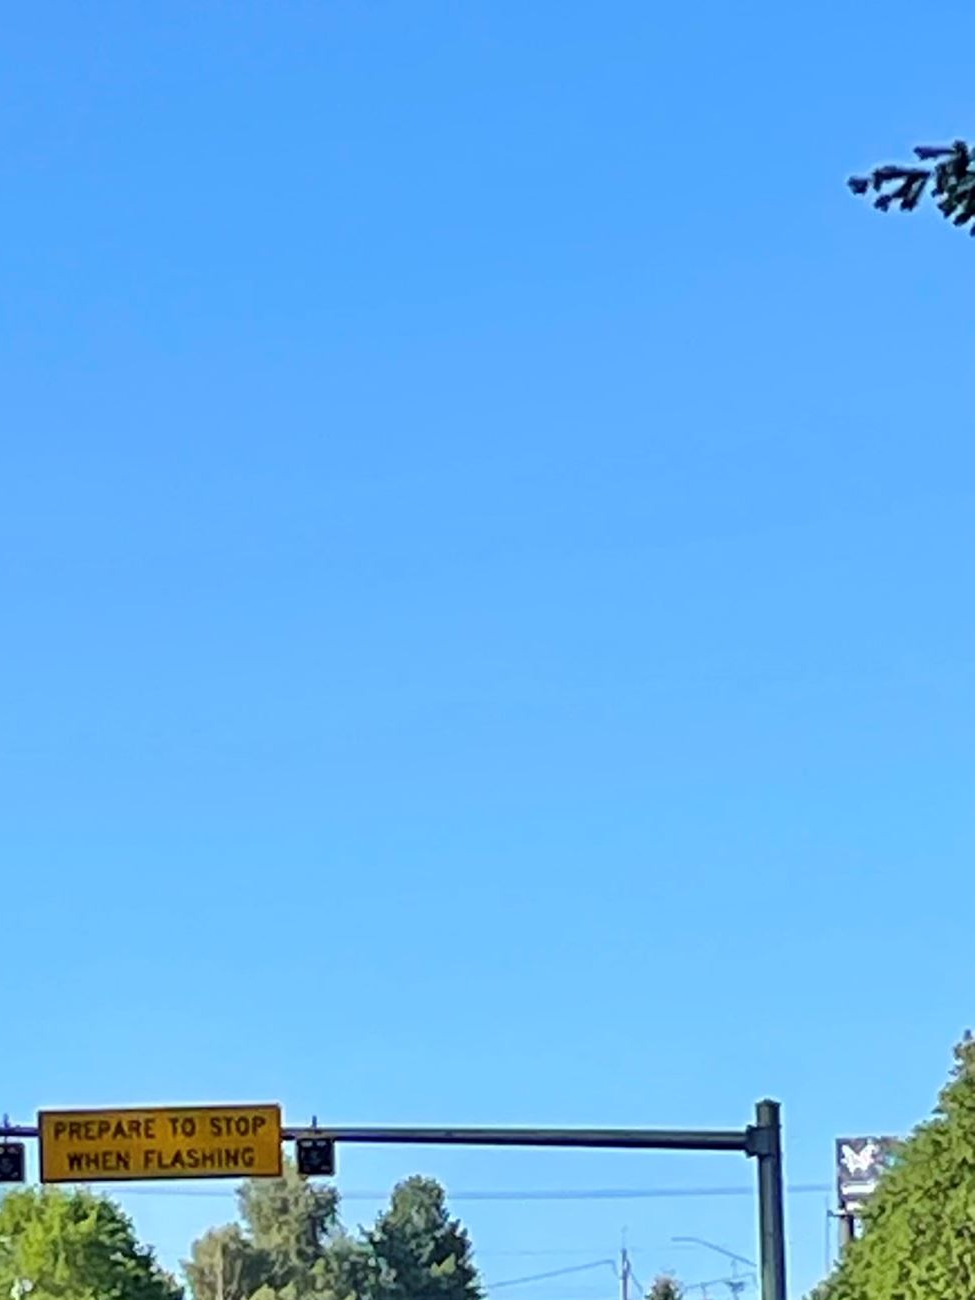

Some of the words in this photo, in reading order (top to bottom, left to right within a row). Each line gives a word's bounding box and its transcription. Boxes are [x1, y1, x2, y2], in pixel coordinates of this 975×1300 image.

[53, 1118, 155, 1140] PREPARE
[169, 1117, 196, 1138] TO
[210, 1115, 266, 1137] STOP
[67, 1150, 130, 1171] WHEN
[144, 1147, 255, 1170] FLASHING
